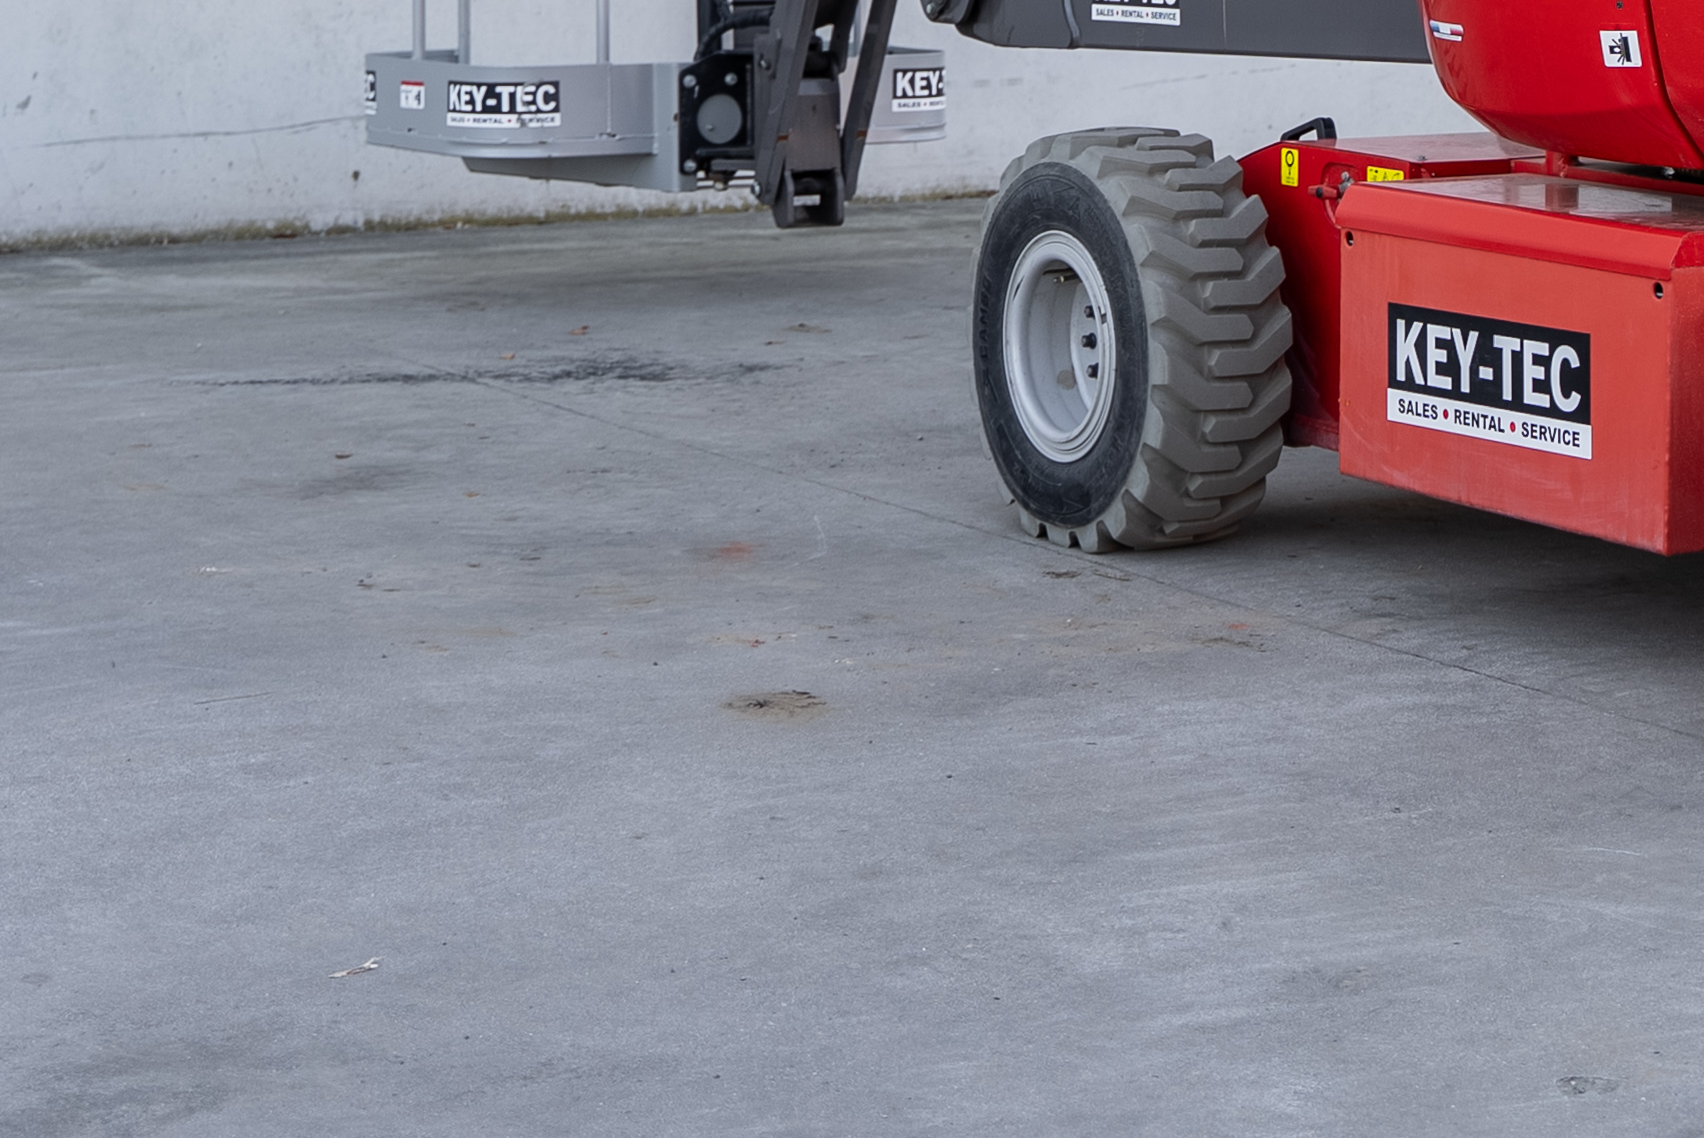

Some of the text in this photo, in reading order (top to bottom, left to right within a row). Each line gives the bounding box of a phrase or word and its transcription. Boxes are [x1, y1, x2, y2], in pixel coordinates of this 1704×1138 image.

[1095, 8, 1177, 21] SALES RENTAL SERVICE
[449, 83, 556, 112] KEY-TEC
[896, 70, 946, 97] KEY-
[1396, 318, 1582, 412] KEY-TEC
[1398, 399, 1580, 448] SALES RENTAL SERVICE
